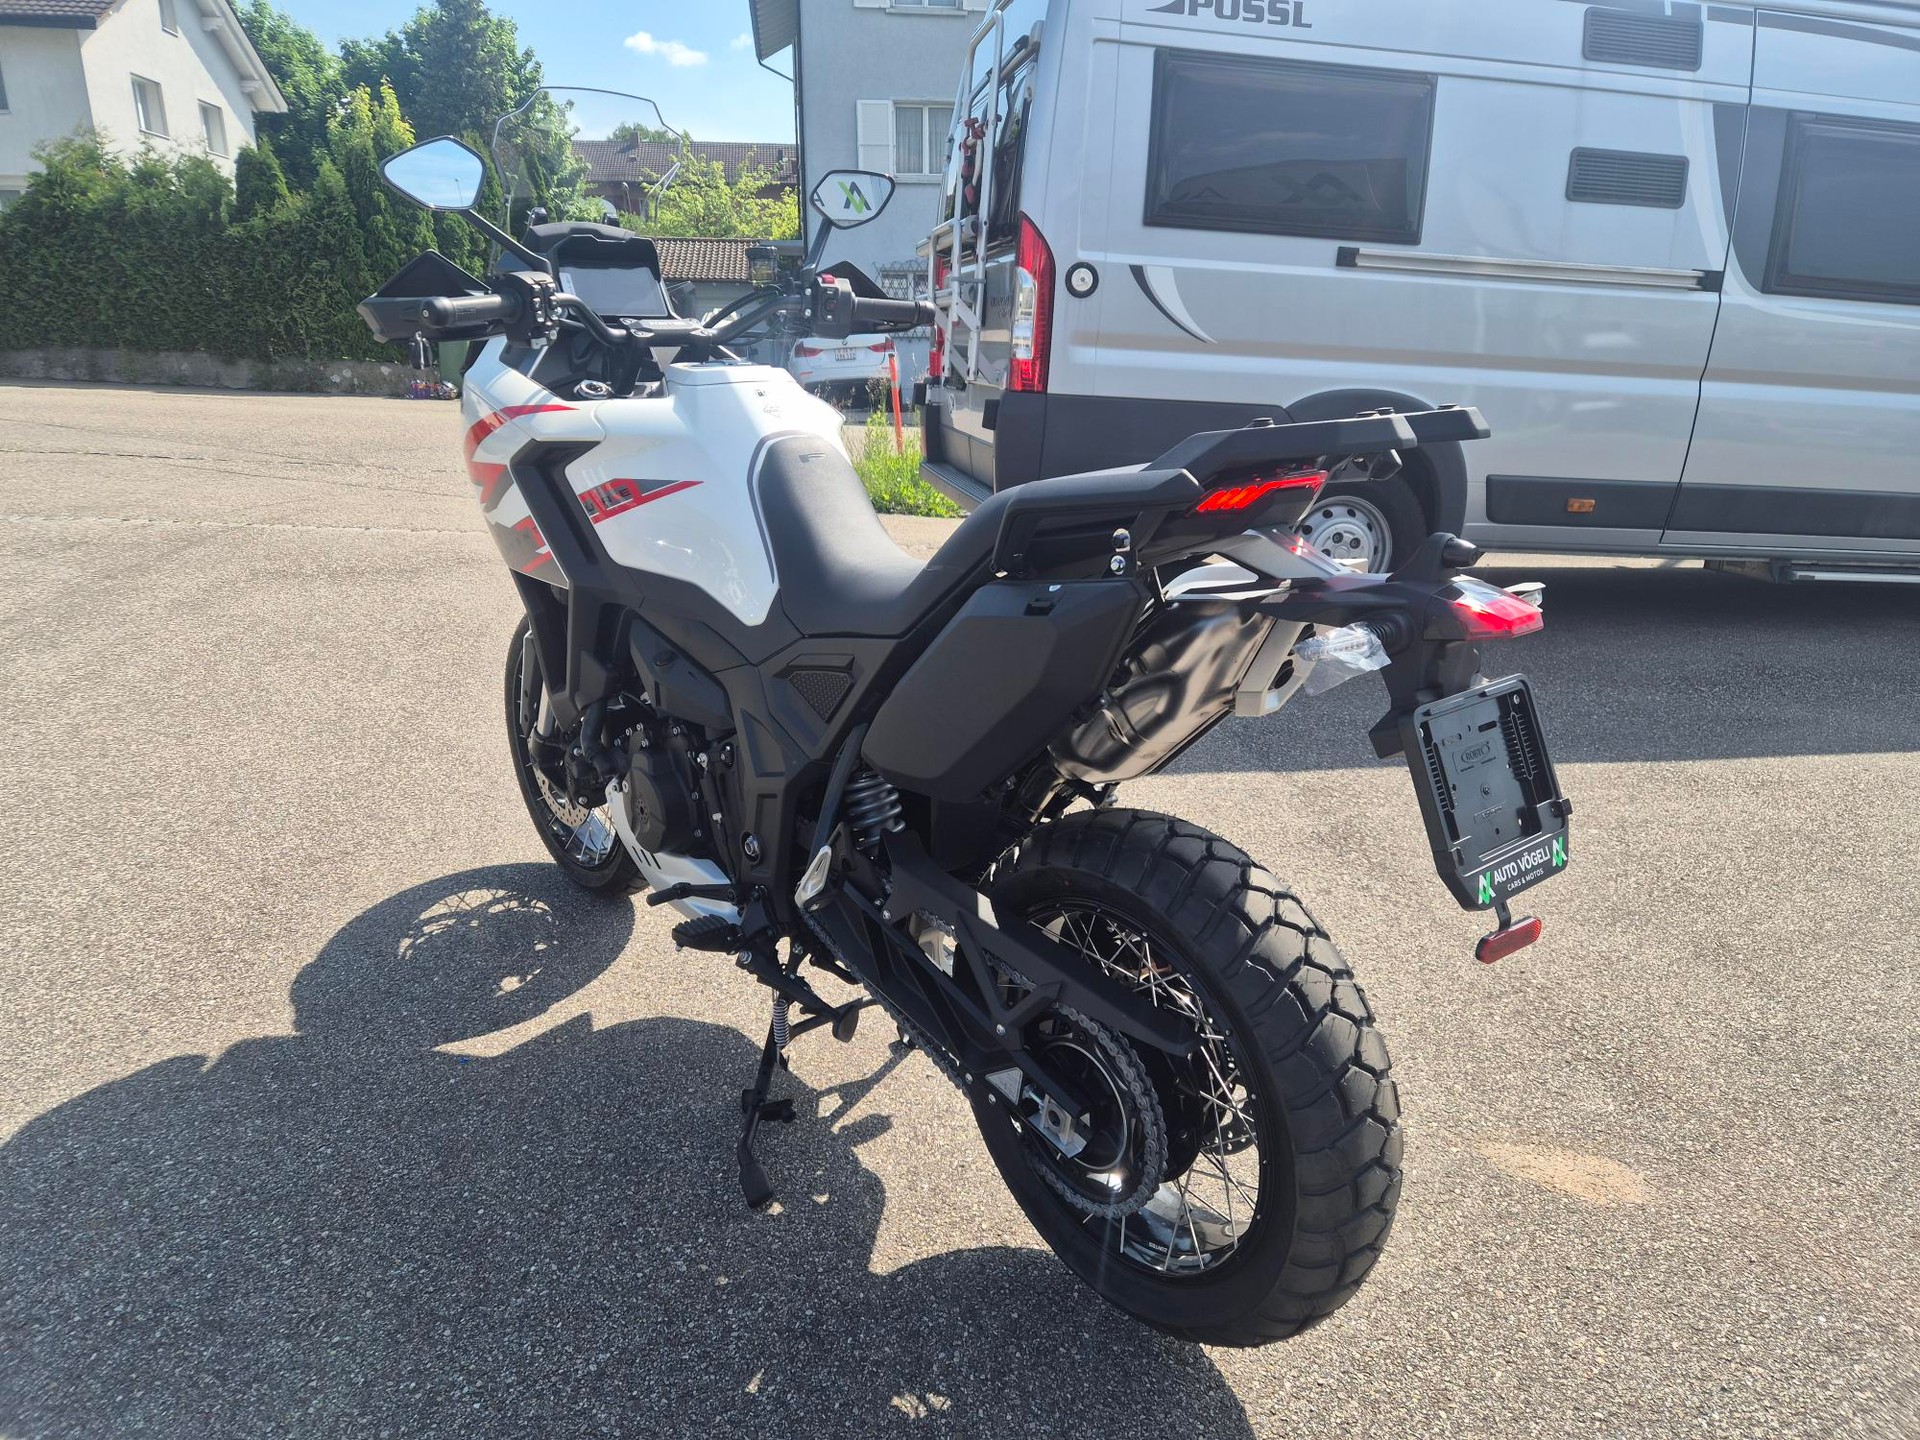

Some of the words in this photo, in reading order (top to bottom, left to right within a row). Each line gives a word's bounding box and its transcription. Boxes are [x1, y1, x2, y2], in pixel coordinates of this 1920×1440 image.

[1494, 861, 1518, 885] AUTO
[1517, 846, 1551, 872] VÖGELI
[1507, 878, 1522, 891] CARS
[1525, 868, 1544, 882] MOTOS
